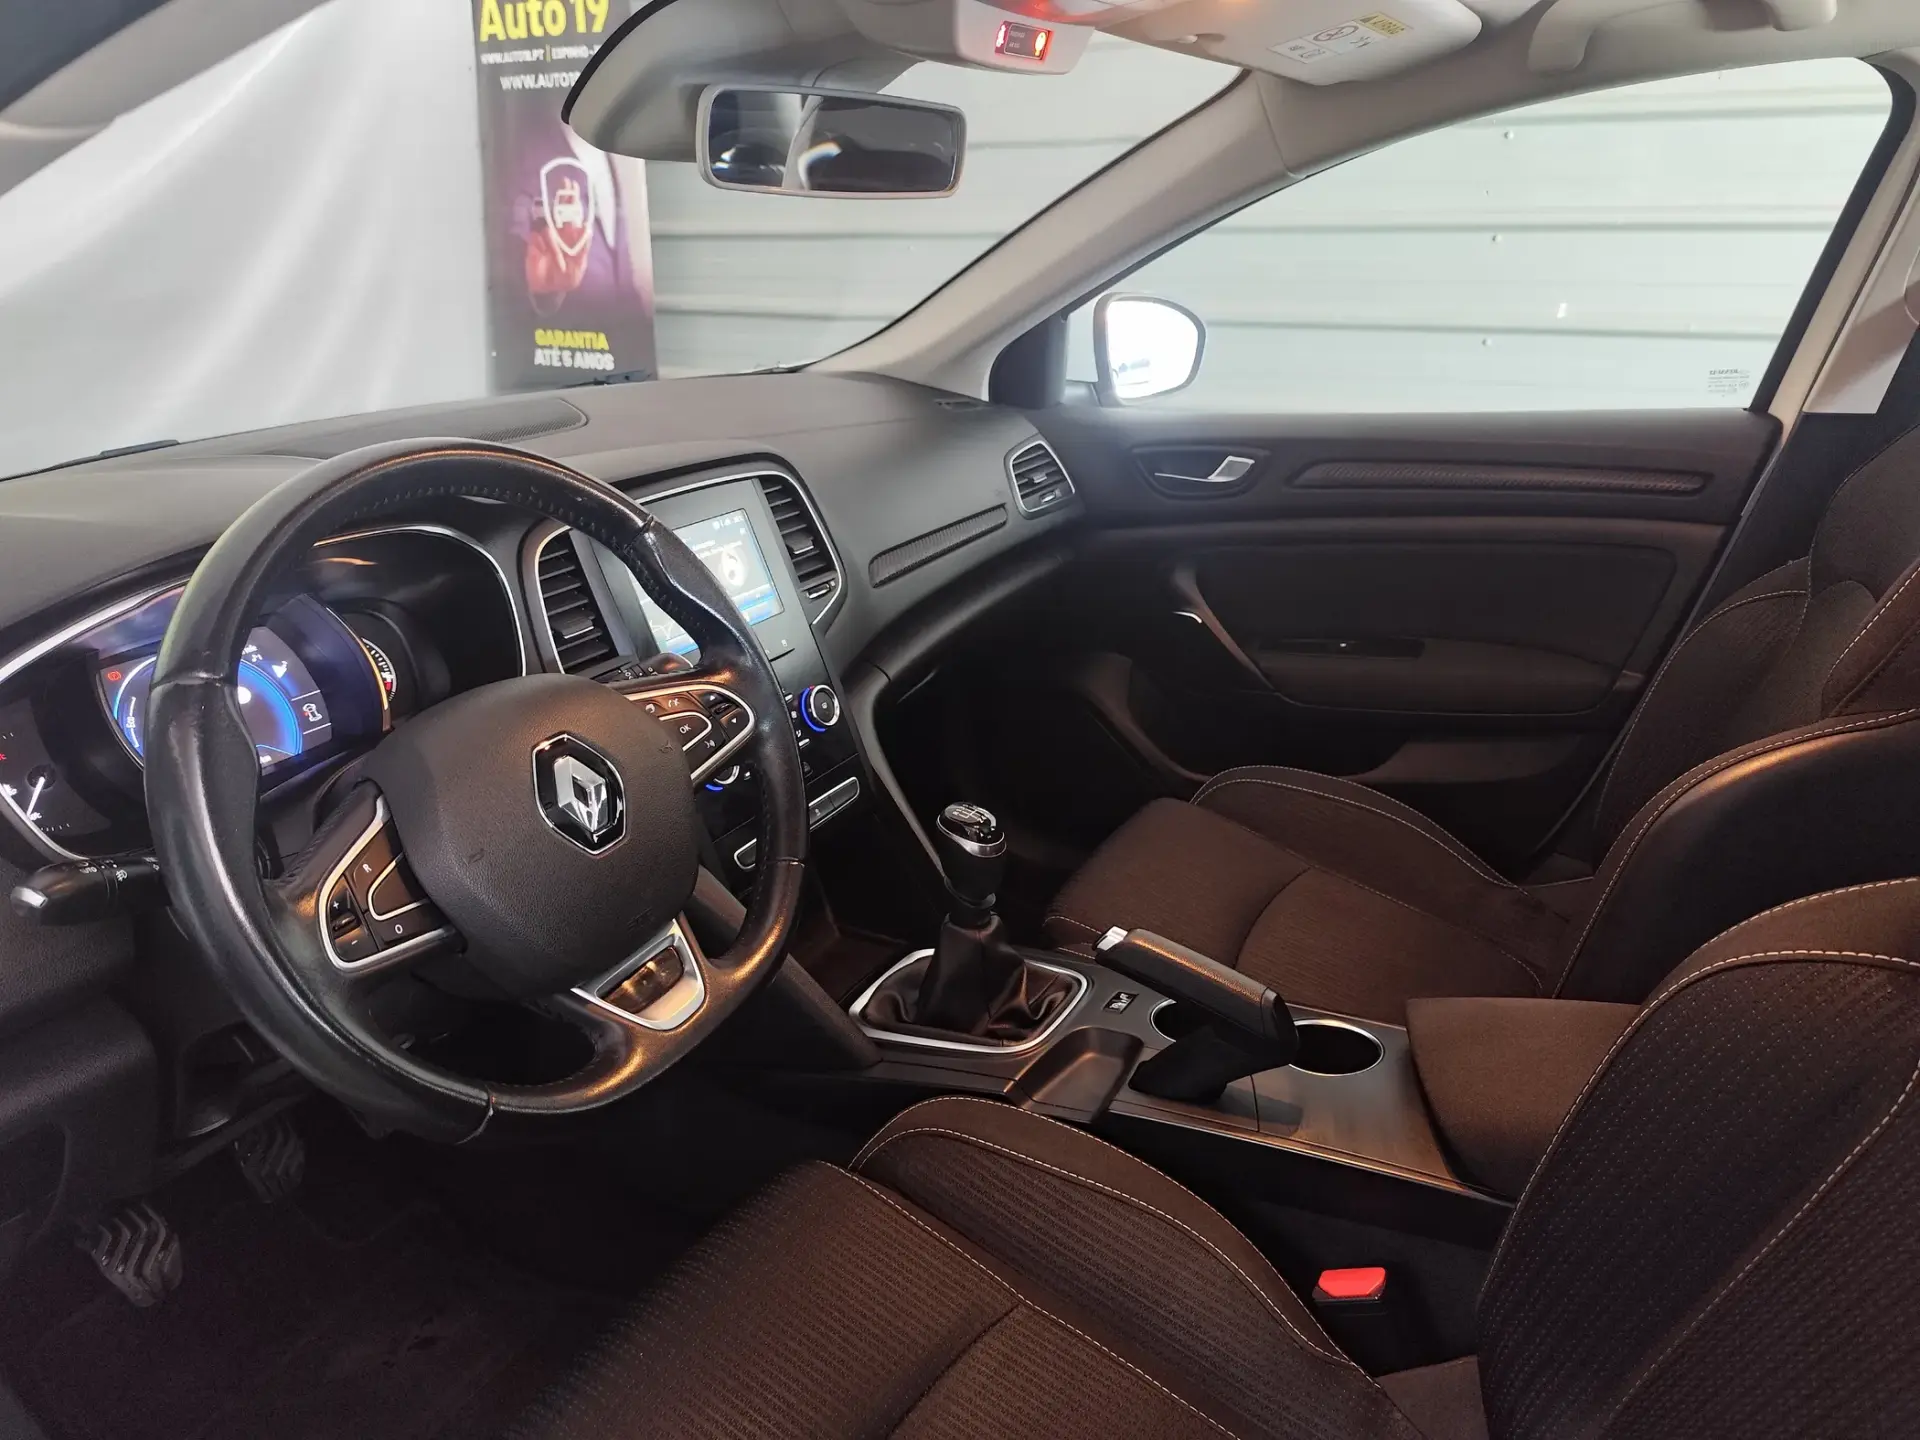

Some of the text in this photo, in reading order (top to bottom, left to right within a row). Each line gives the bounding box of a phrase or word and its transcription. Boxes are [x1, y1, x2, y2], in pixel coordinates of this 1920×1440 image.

[480, 0, 609, 42] Auto 19
[534, 328, 609, 350] GARANTIA
[574, 352, 615, 371] ANOS
[680, 723, 691, 734] OK
[362, 863, 372, 873] R
